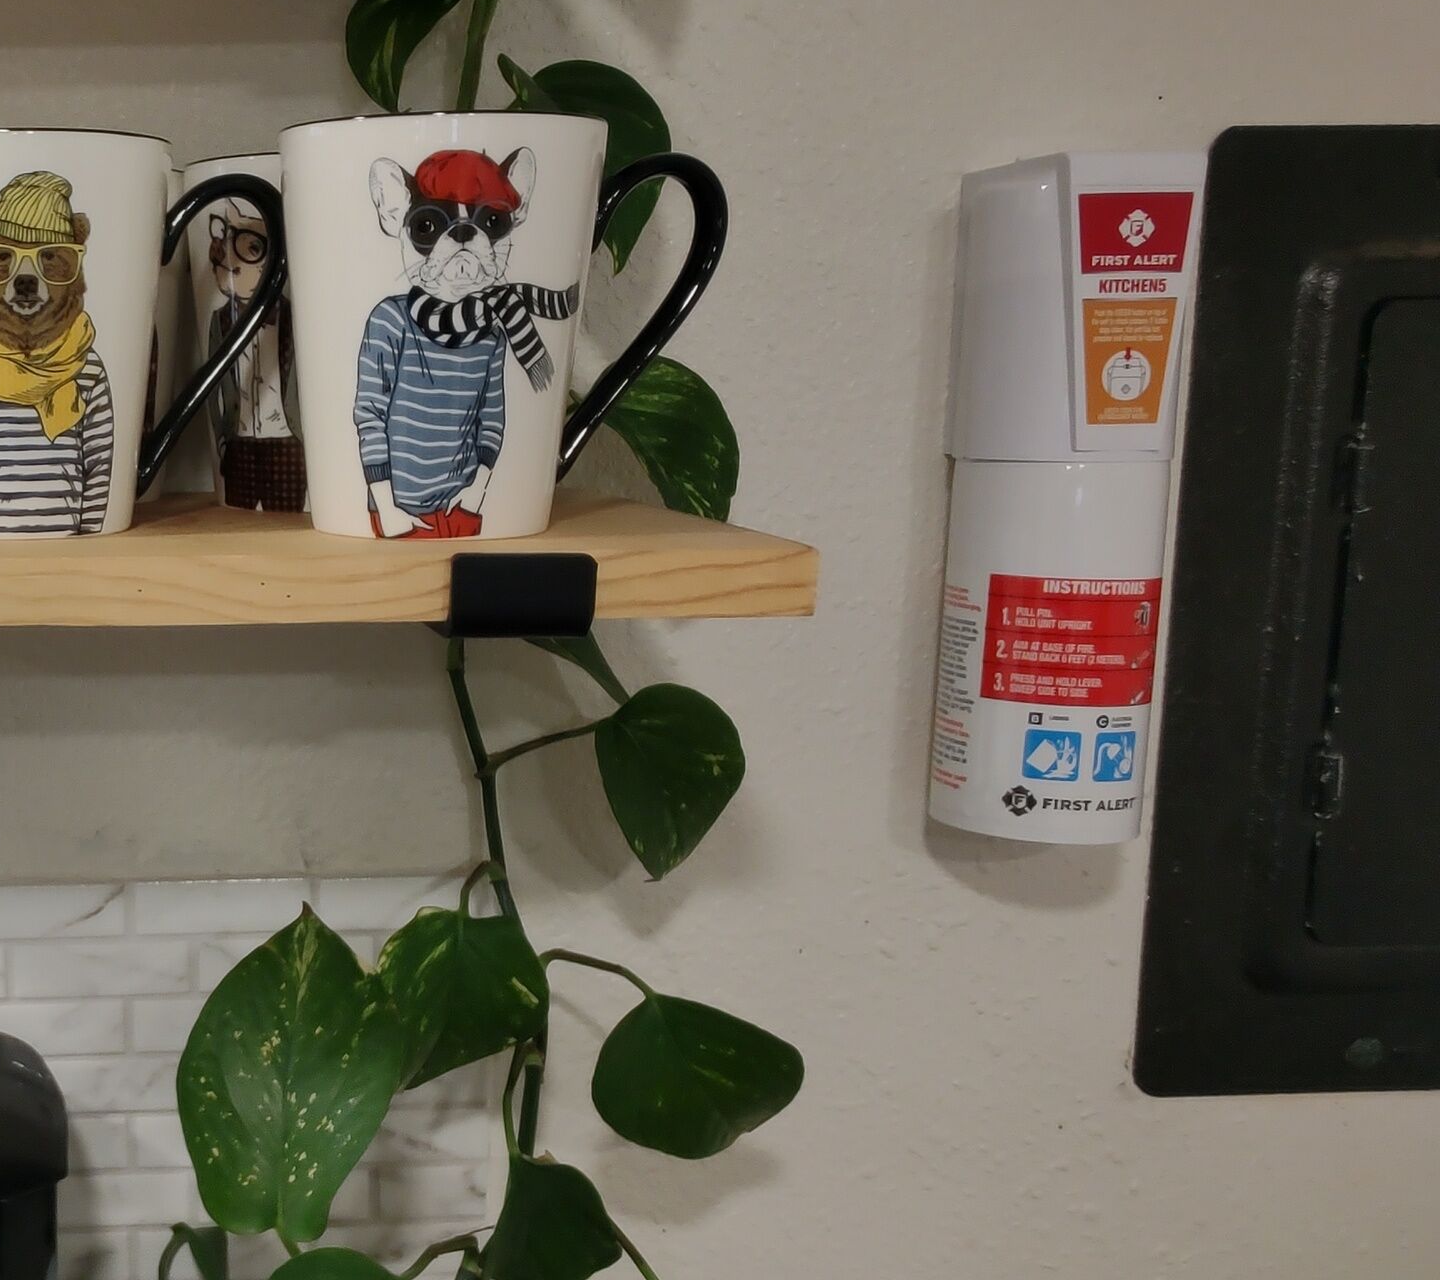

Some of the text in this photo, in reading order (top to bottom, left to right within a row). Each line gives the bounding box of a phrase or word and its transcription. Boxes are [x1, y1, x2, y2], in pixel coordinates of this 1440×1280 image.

[1091, 254, 1178, 266] FIRST ALERT
[1098, 278, 1167, 294] KITCHEN5
[1043, 579, 1146, 595] INSTRUCTIONS
[1001, 607, 1010, 626] 1.
[995, 639, 1008, 658] 2.
[1030, 641, 1041, 652] AT
[1042, 642, 1063, 653] BASE
[1064, 643, 1076, 654] OF
[1068, 654, 1087, 664] FEET
[993, 672, 1005, 691] 3.
[1036, 674, 1054, 686] AND
[1058, 686, 1068, 697] TO
[1042, 798, 1092, 811] FIRST
[1095, 797, 1137, 811] ALERT
